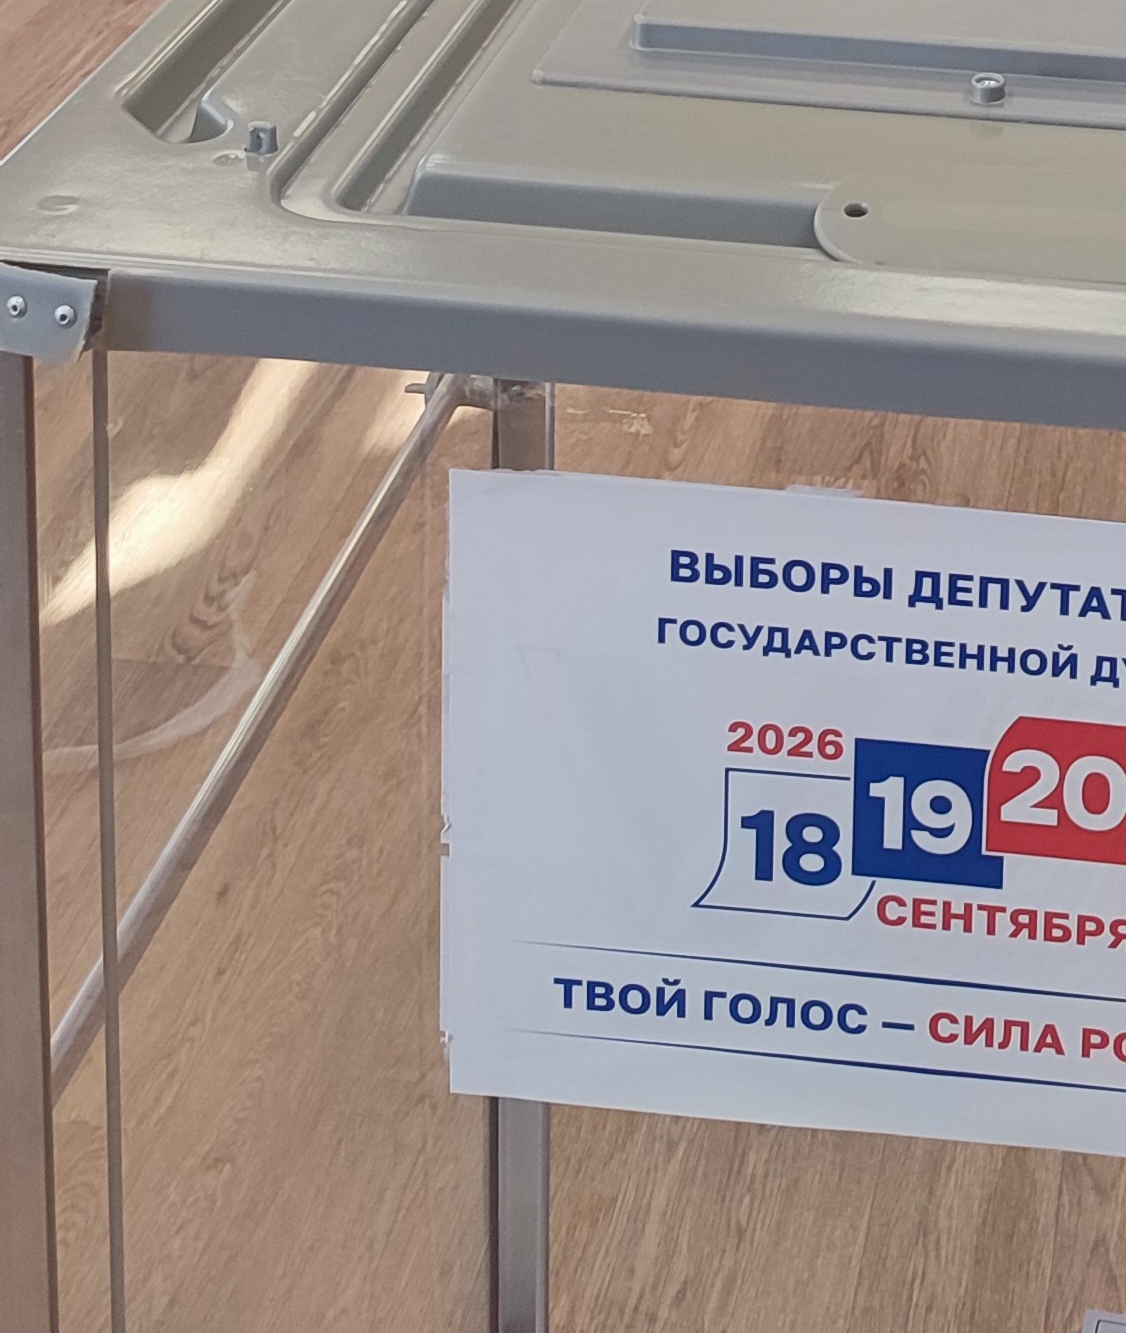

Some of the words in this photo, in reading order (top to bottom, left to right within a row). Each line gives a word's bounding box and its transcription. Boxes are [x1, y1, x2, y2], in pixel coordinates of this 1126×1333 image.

[671, 550, 893, 600] ВЫБОРЫ
[657, 618, 1078, 680] ГОСУДАРСТВЕННОЙ
[727, 721, 844, 761] 2026
[741, 810, 843, 886] 18
[867, 775, 973, 856] 19
[554, 977, 687, 1019] ТВОЙ
[703, 991, 868, 1035] ГОЛОС
[929, 1013, 1065, 1056] СИЛА
